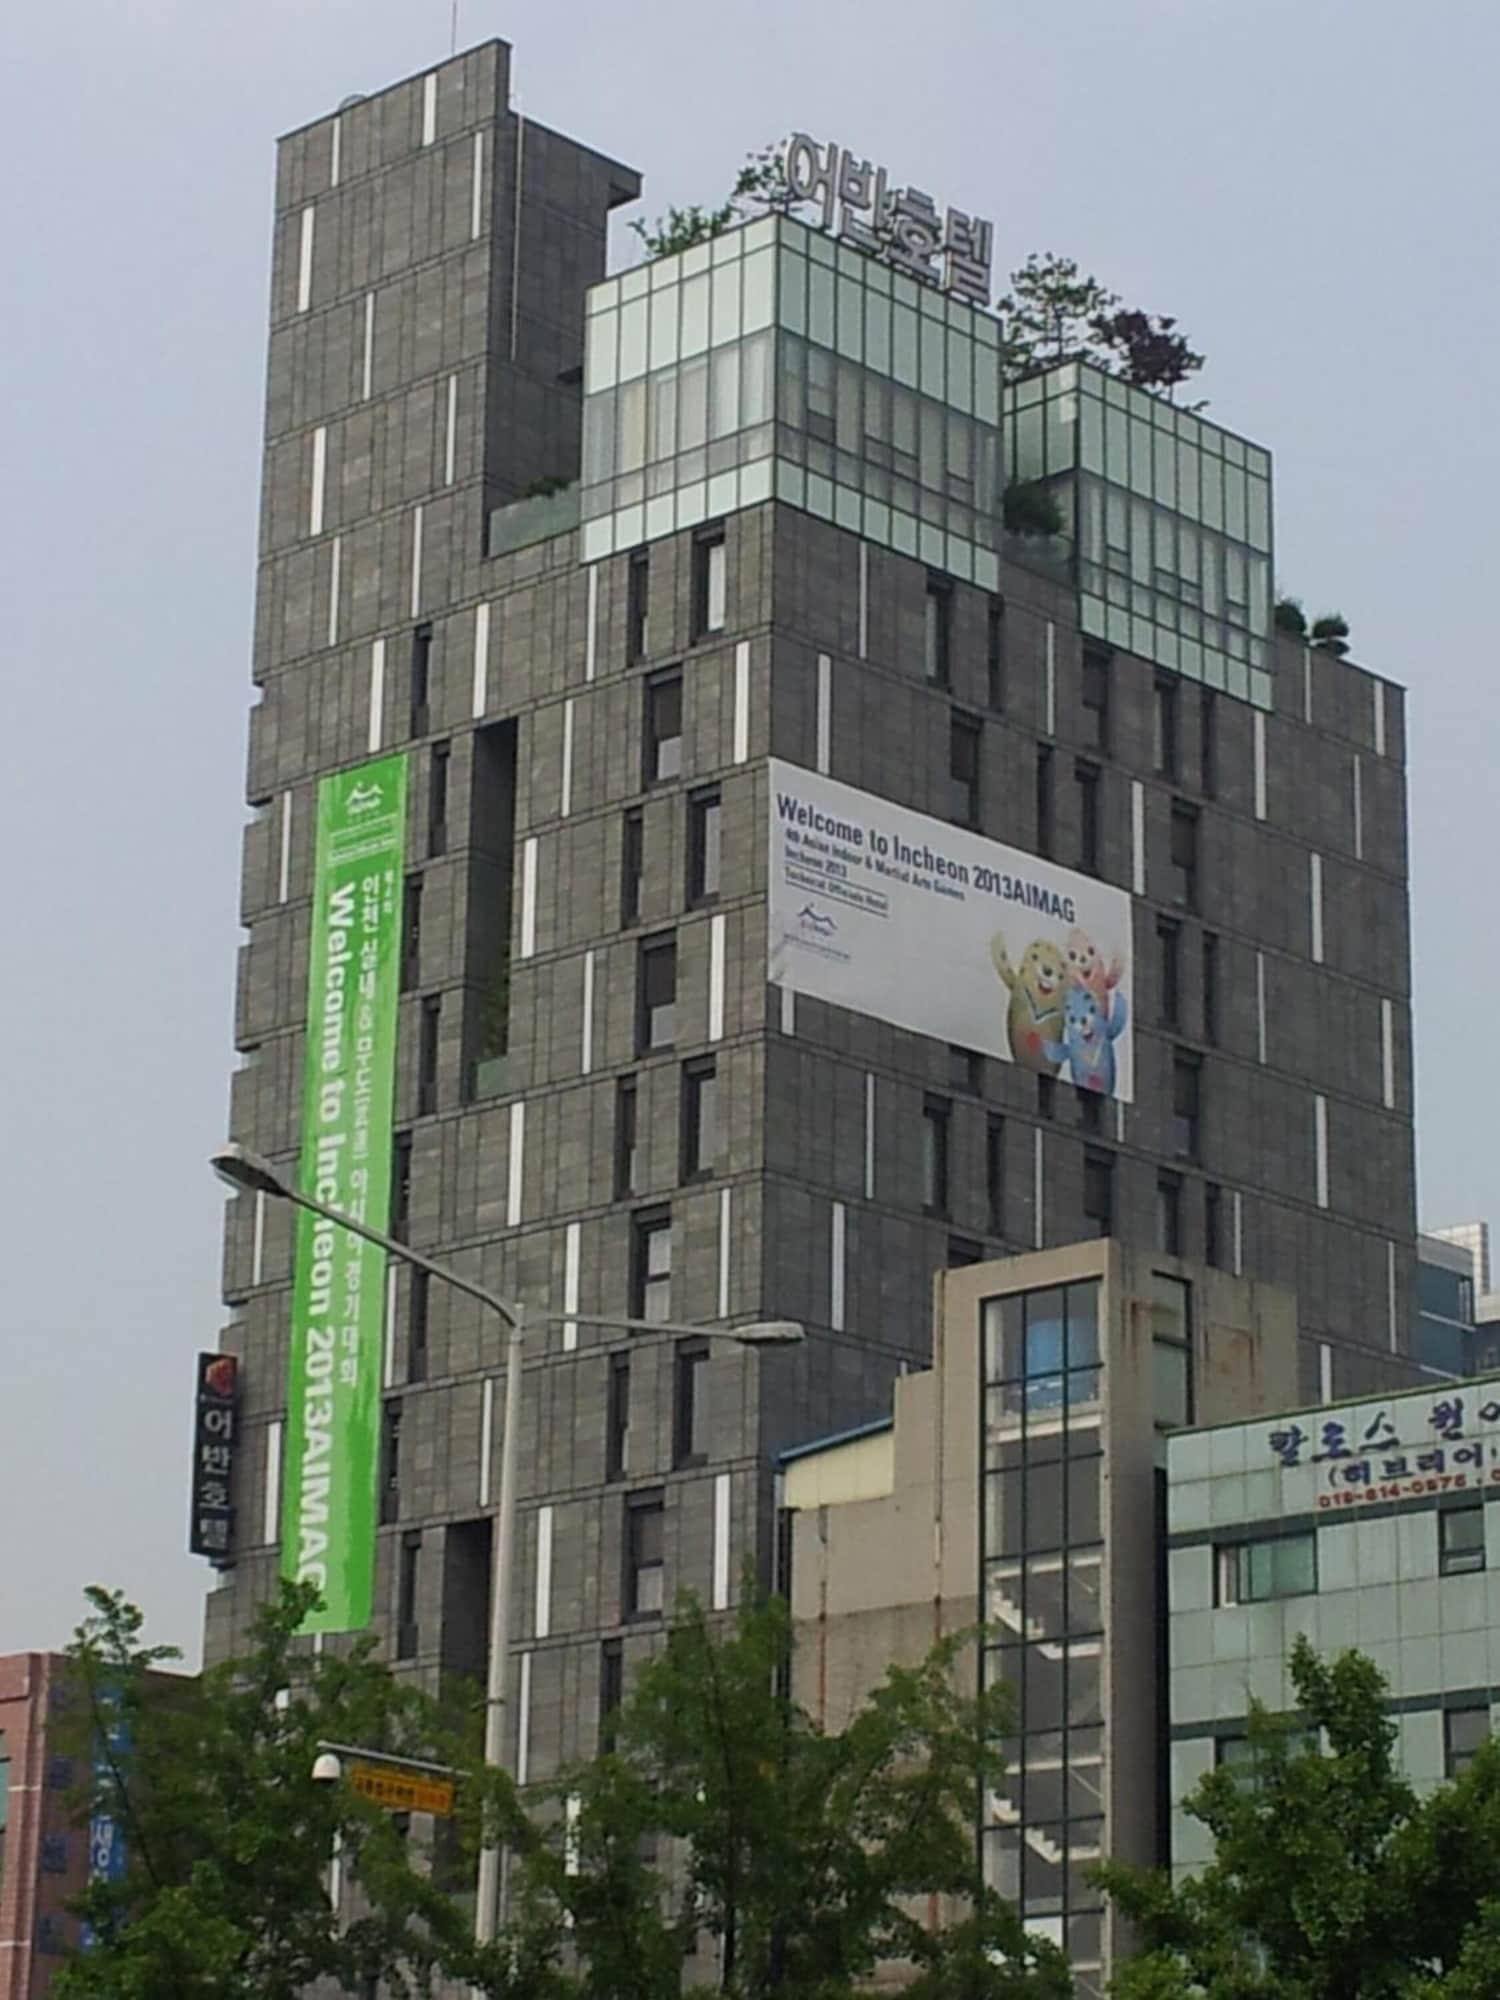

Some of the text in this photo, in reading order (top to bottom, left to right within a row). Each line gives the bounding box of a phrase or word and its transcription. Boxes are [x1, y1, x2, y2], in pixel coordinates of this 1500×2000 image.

[787, 132, 993, 306] 어반호텔
[777, 793, 1076, 923] Welcome to Incheon 2013AIMAG
[803, 834, 829, 853] Asian
[876, 858, 908, 882] Martial
[912, 873, 931, 890] Arts
[322, 881, 356, 1071] Welcome
[319, 1078, 347, 1123] to
